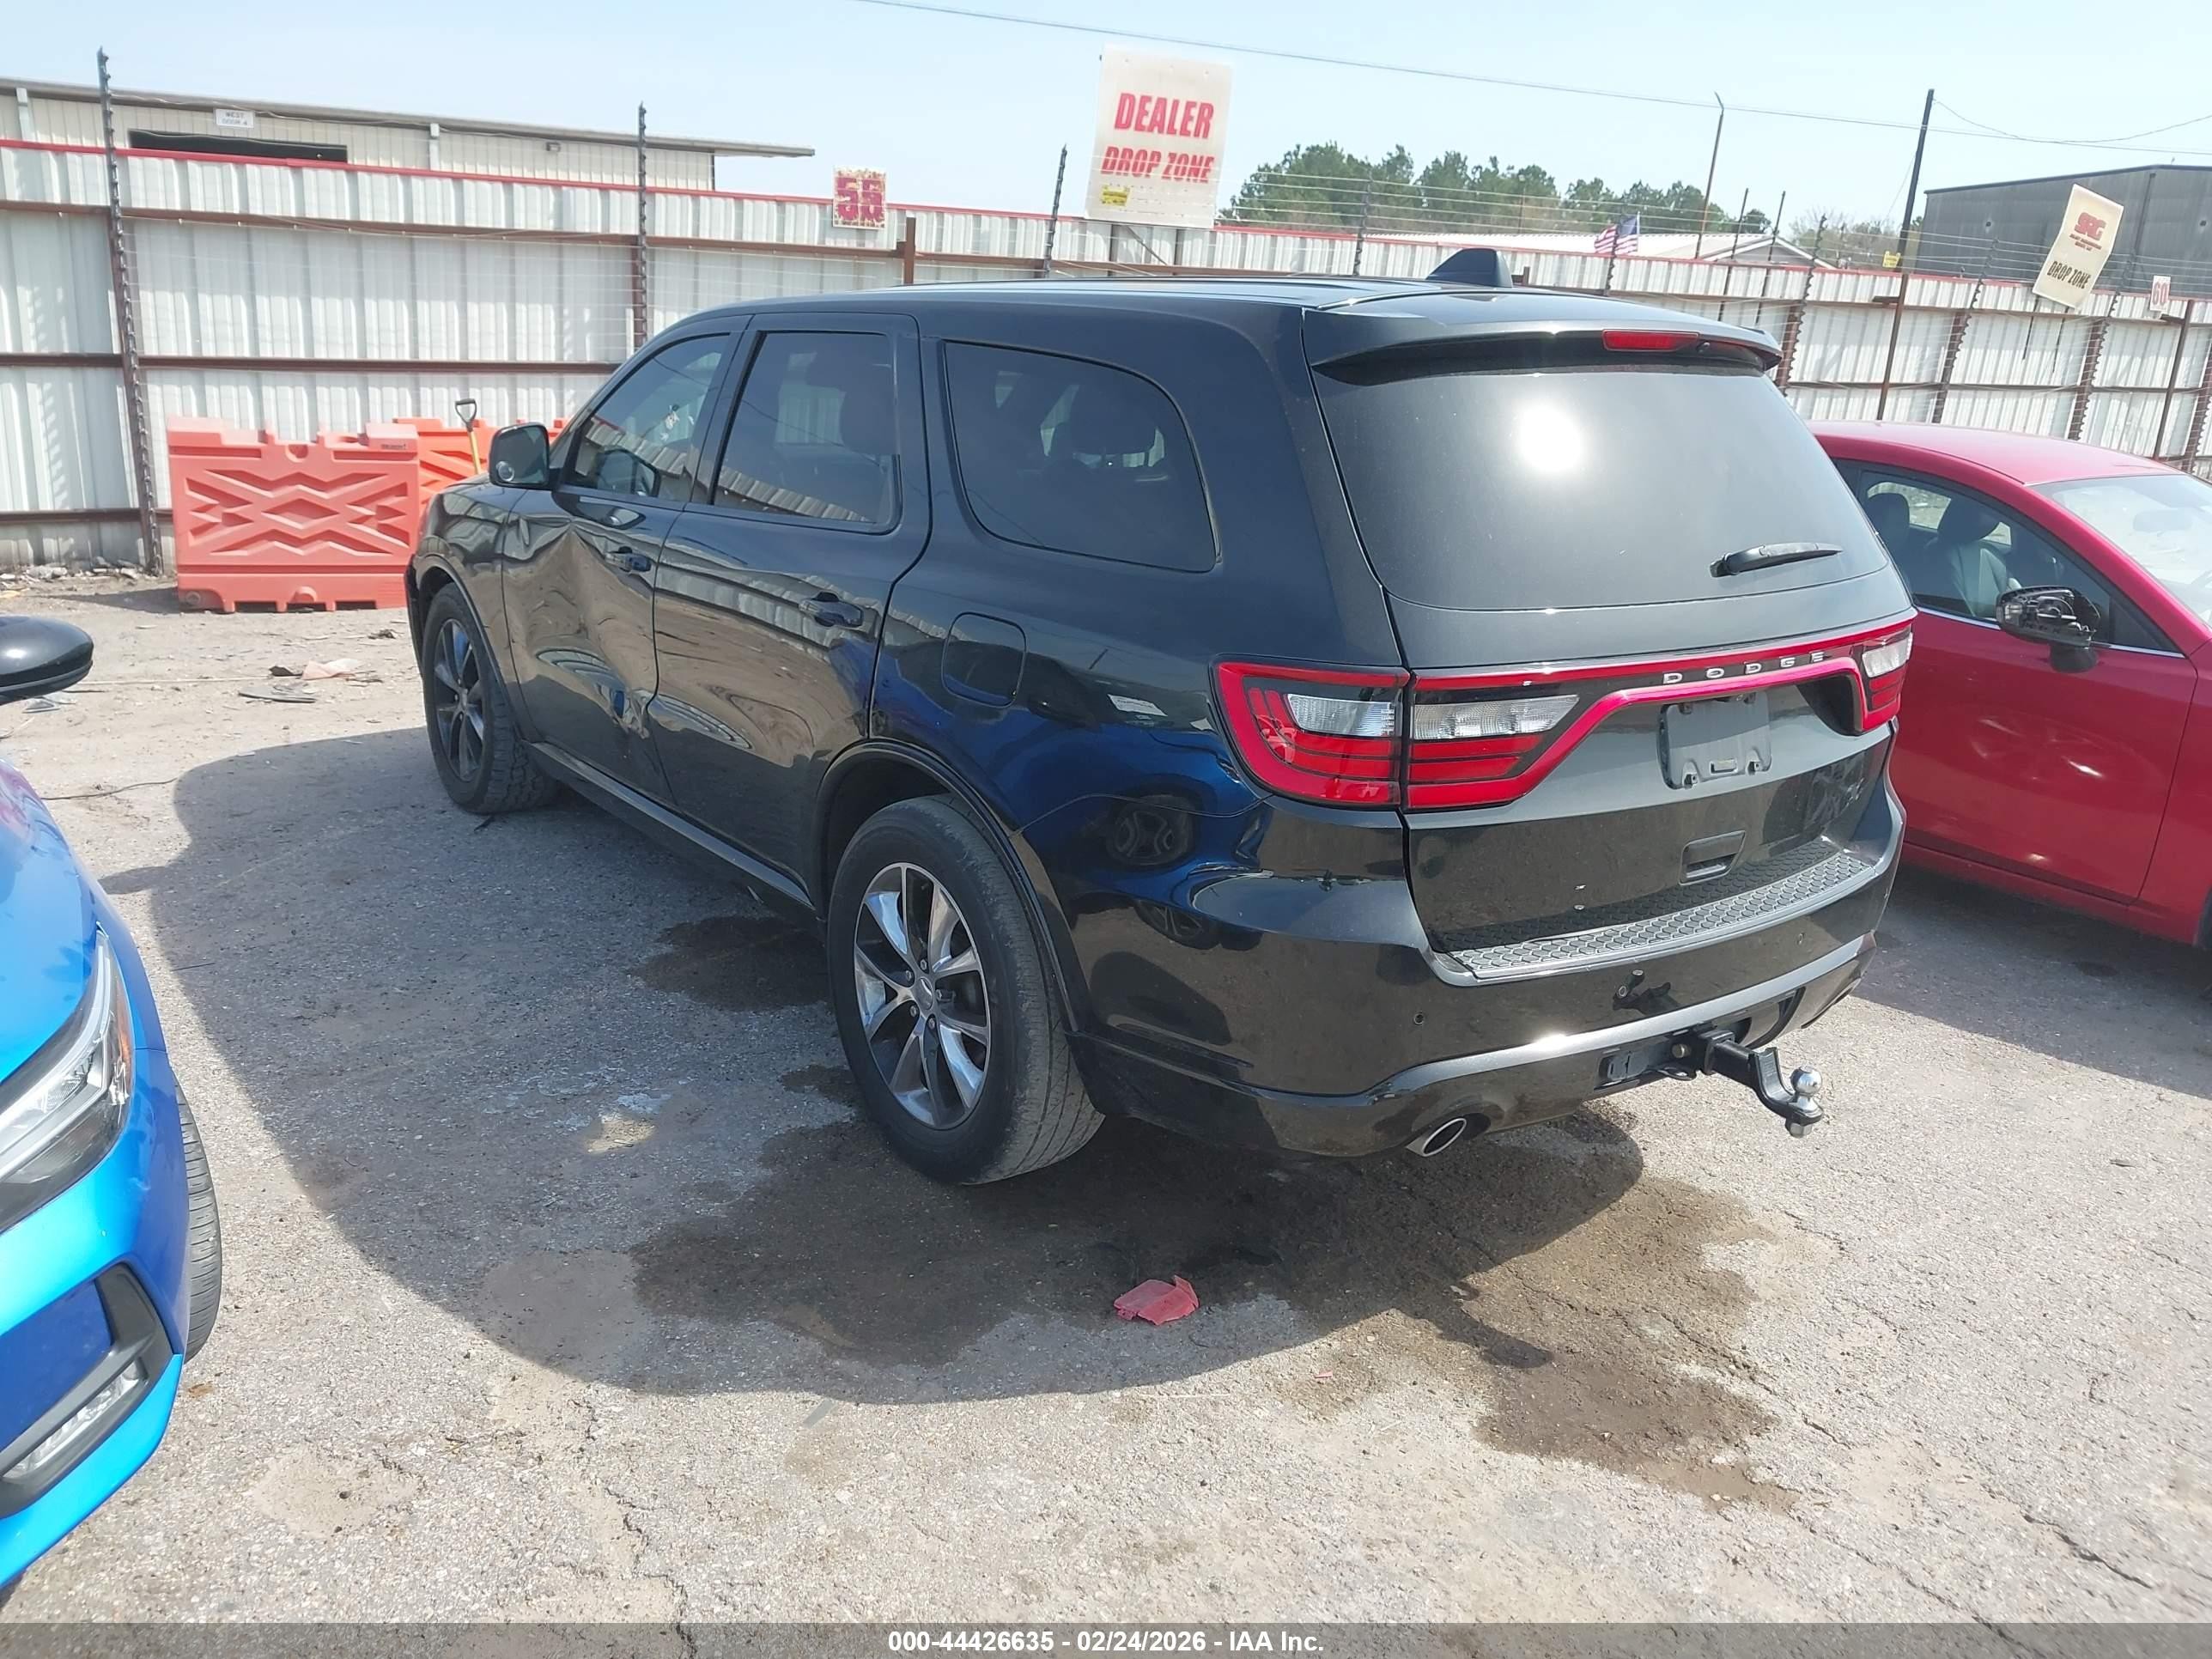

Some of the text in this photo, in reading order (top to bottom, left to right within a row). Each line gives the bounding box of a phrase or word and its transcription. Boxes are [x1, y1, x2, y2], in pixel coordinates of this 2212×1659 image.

[1114, 93, 1214, 139] DEALER
[1100, 146, 1214, 184] DROP ZONE
[2046, 261, 2091, 289] DROP ZONE
[2152, 282, 2169, 306] 60
[1662, 651, 1826, 684] DODGE
